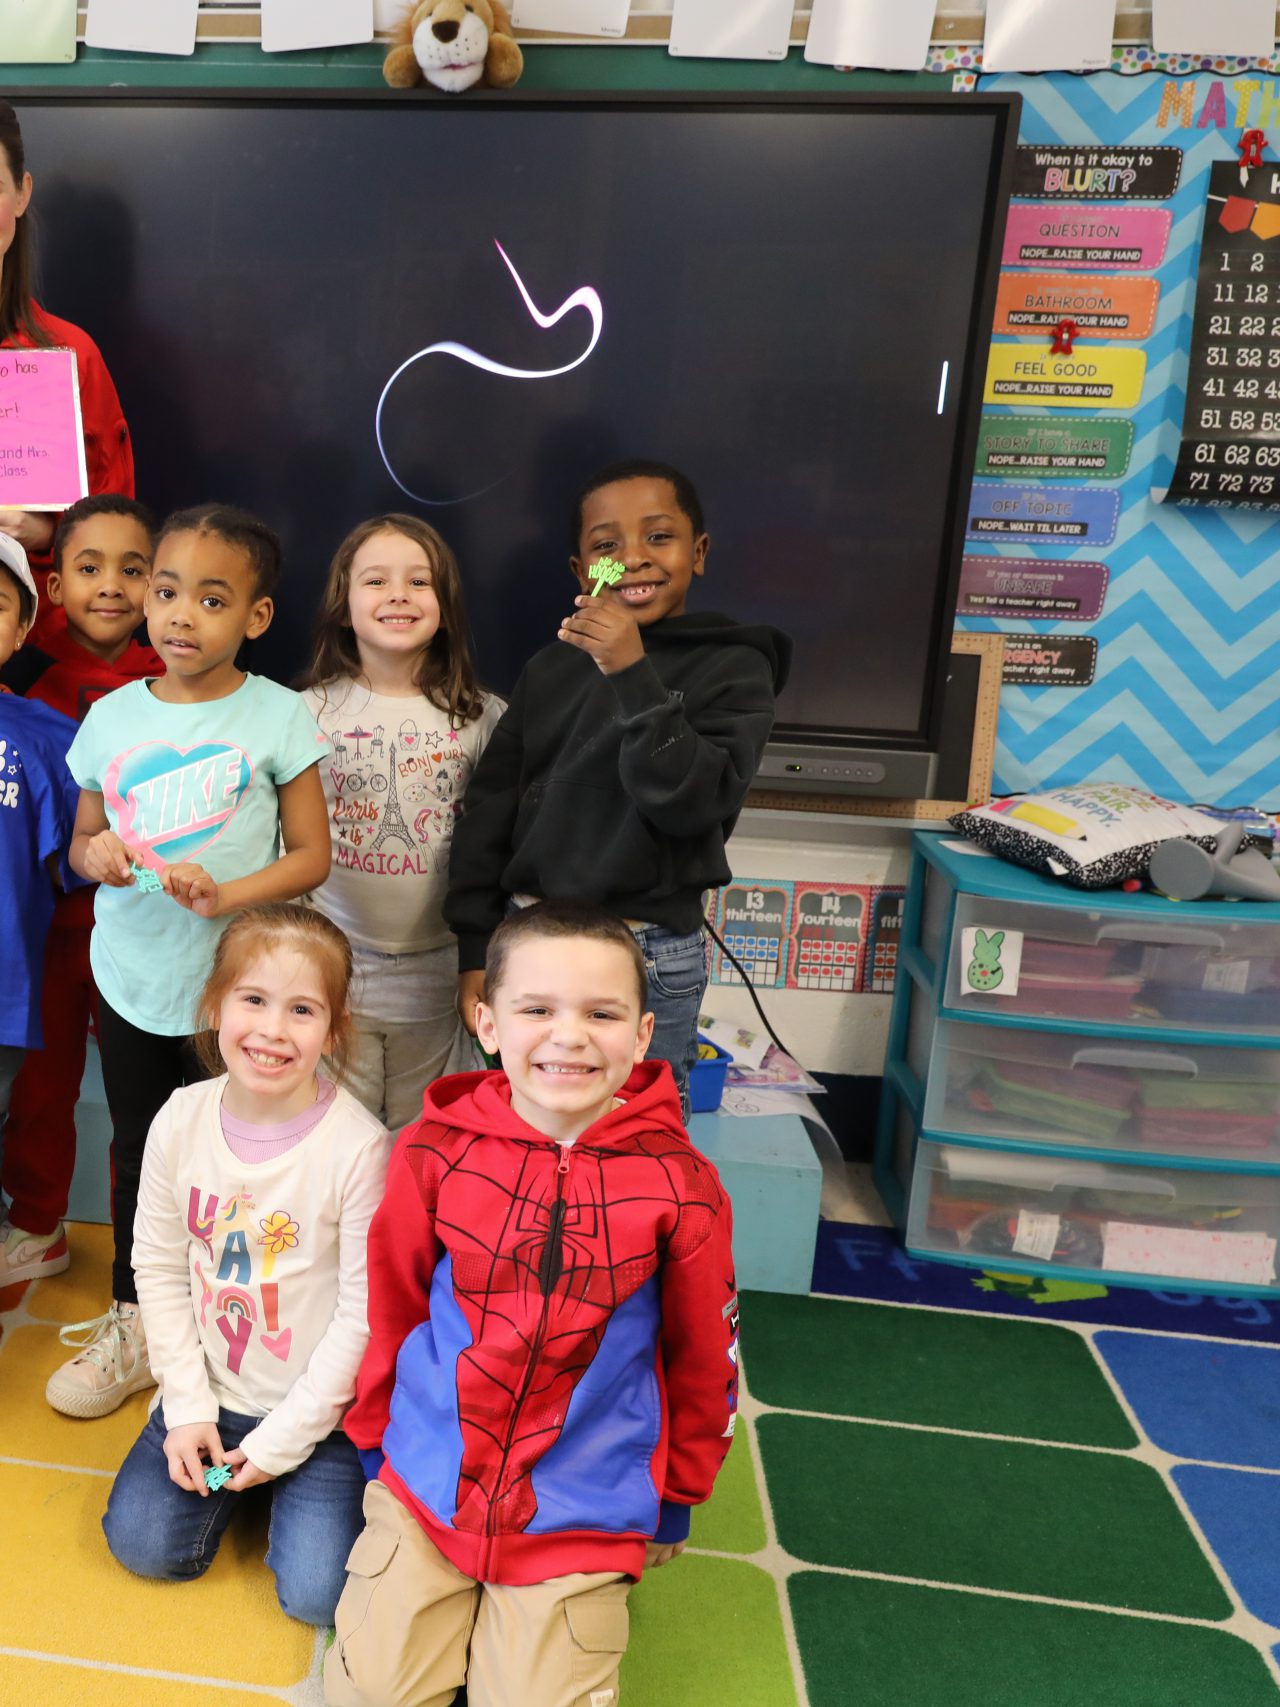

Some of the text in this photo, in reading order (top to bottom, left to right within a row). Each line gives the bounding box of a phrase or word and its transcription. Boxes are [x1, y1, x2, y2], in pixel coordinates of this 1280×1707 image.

[1156, 79, 1280, 129] MATH
[1035, 153, 1153, 168] When is it okay to
[1044, 167, 1137, 193] BLURT?
[1039, 223, 1121, 238] QUESTION
[1086, 249, 1111, 260] YOUR
[1112, 249, 1141, 261] HAND
[1220, 253, 1264, 272] 1 2
[1024, 295, 1112, 309] BATHROOM
[1214, 284, 1269, 304] 11 12
[1073, 315, 1097, 326] YOUR
[1099, 315, 1128, 327] HAND
[1209, 315, 1266, 336] 21 22
[1206, 346, 1262, 368] 31 32
[15, 359, 39, 375] has
[1014, 361, 1098, 377] FEEL GOOD
[1058, 384, 1083, 395] YOUR
[1084, 385, 1112, 396] HAND
[1202, 377, 1226, 397] 41
[1233, 379, 1259, 399] 42
[1200, 409, 1222, 429] 51
[1229, 410, 1255, 430] 52
[984, 436, 1110, 451] STORY TO SHARE
[27, 446, 51, 459] Mrs.
[1194, 443, 1216, 463] 61
[1224, 445, 1250, 466] 62
[1051, 456, 1076, 466] YOUR
[1078, 456, 1105, 467] HAND
[1189, 472, 1275, 494] 71 72 73
[991, 500, 1073, 516] OFF TOPIC
[1036, 523, 1052, 532] TIL
[1053, 523, 1081, 534] LATER
[993, 579, 1054, 595] UNSAFE
[1006, 597, 1035, 606] teacher
[1036, 599, 1055, 609] right
[1056, 600, 1078, 609] away
[1005, 642, 1022, 650] here
[1024, 642, 1031, 650] is
[1004, 650, 1061, 665] RGENCY
[1004, 665, 1076, 676] acher right away
[130, 749, 243, 841] NIKE
[333, 797, 380, 826] Paris
[1050, 791, 1122, 828] HAPPY.
[349, 824, 364, 846] is
[336, 848, 428, 876] MAGICAL
[746, 891, 765, 909] 13
[821, 895, 841, 914] 14
[725, 907, 782, 923] thirteen
[798, 912, 862, 928] fourteen
